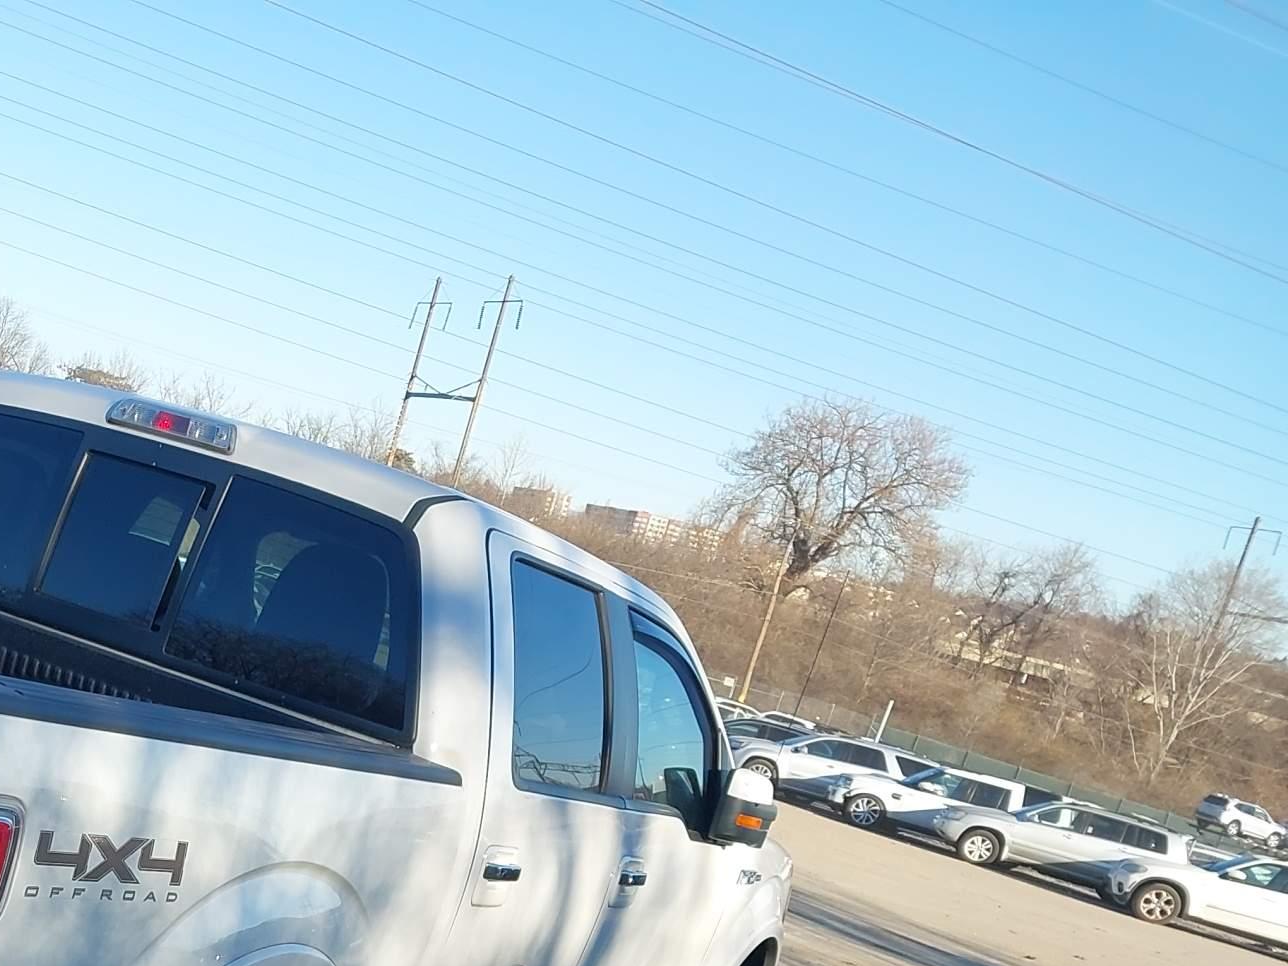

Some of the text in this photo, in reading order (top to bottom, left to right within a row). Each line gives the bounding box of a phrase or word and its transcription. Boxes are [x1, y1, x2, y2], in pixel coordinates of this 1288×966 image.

[34, 830, 189, 886] 4X4
[24, 885, 179, 903] OFF ROAD
